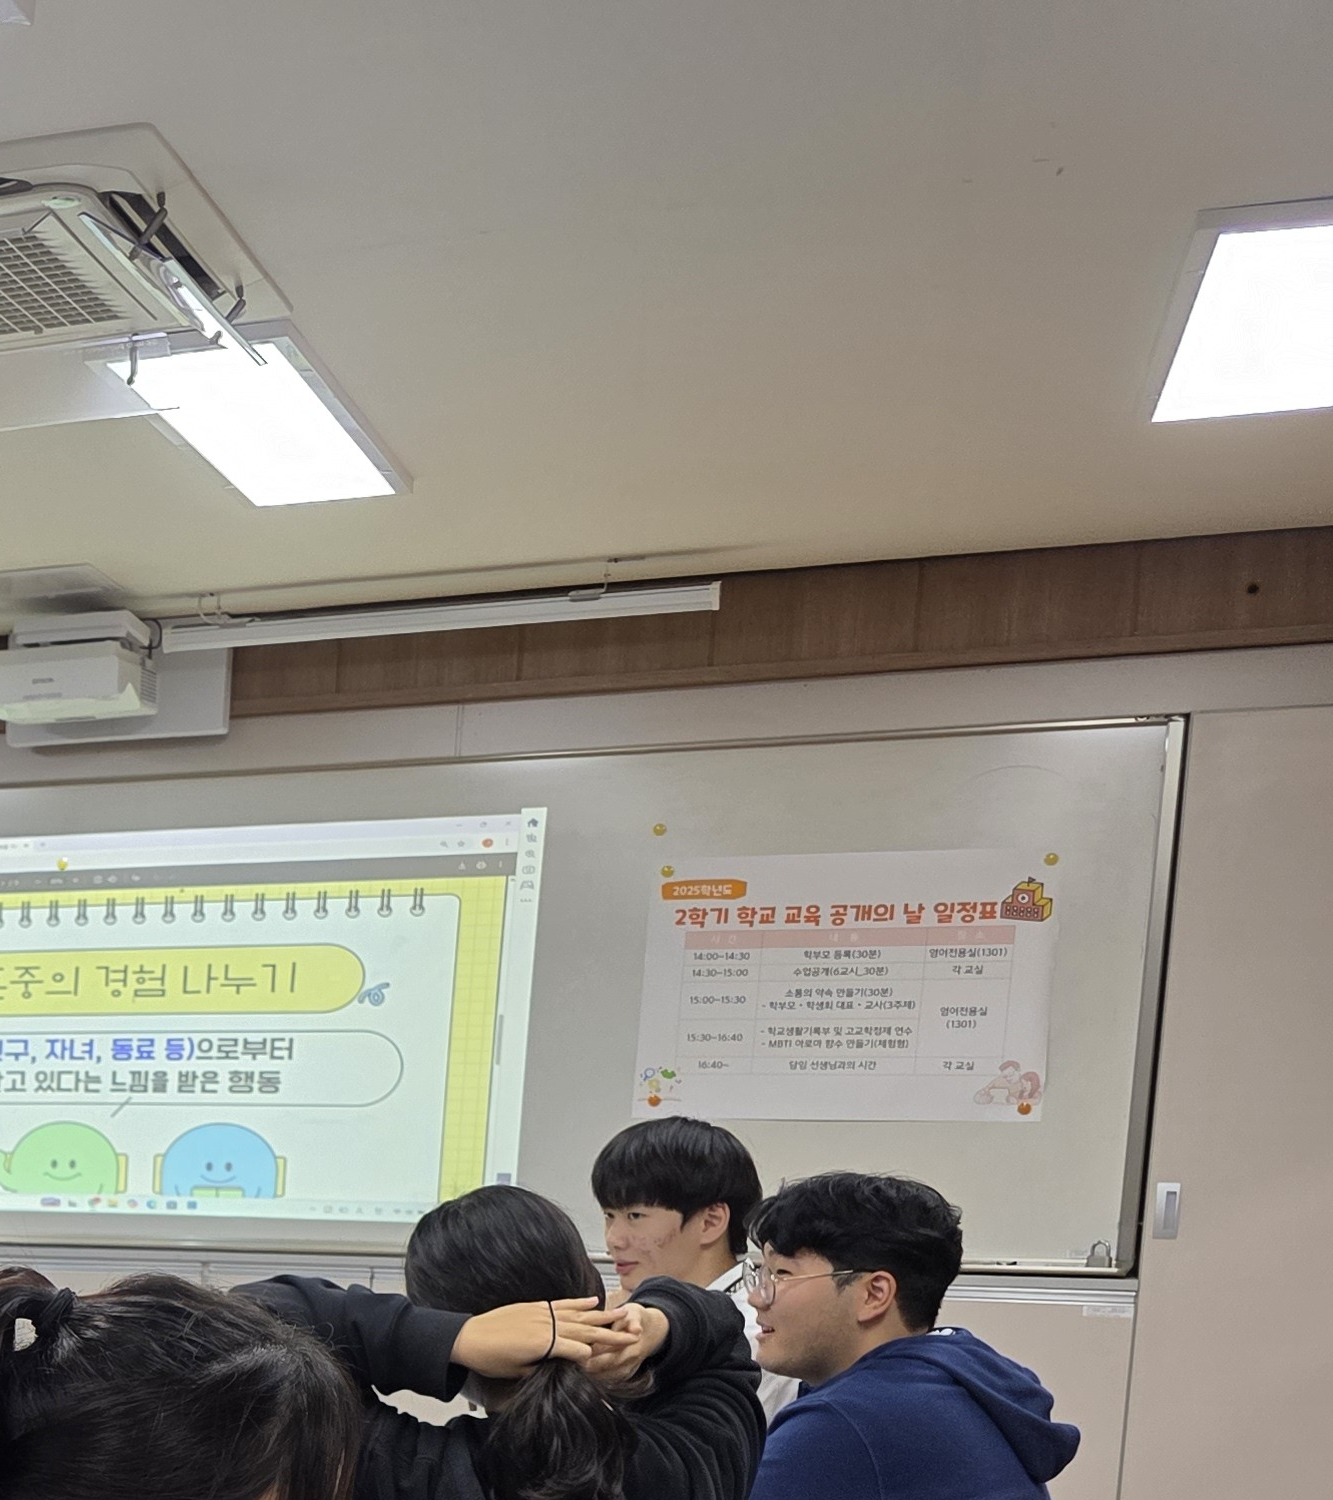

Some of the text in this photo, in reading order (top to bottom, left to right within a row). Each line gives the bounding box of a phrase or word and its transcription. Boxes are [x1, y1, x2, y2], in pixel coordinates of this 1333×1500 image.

[673, 884, 732, 896] 2025학년도
[674, 901, 998, 928] 2학기 학교 교육 공개의 날 일정표
[804, 950, 829, 960] 학부모
[929, 947, 1008, 958] 영어전용실(1301)
[952, 965, 983, 975] 각 교실
[96, 963, 166, 997] 경험
[182, 962, 297, 995] 나누기
[785, 987, 812, 998] 소통의
[836, 987, 893, 997] 만들기(30분)
[769, 1001, 796, 1010] 학부모
[836, 1000, 853, 1010] 대표
[940, 1006, 987, 1017] 영어전용실
[946, 1019, 976, 1029] (1301)
[833, 1026, 842, 1036] 및
[769, 1040, 792, 1048] MBTI
[795, 1039, 821, 1048] 아로마
[45, 1038, 101, 1064] 자녀,
[111, 1038, 155, 1061] 동료
[165, 1037, 293, 1062] 등)으로부터
[859, 1060, 876, 1070] 시간
[943, 1060, 974, 1070] 각 교실
[34, 1070, 102, 1094] 있다는
[110, 1070, 169, 1094] 느낌을
[178, 1070, 219, 1094] 받은
[228, 1069, 281, 1094] 행동
